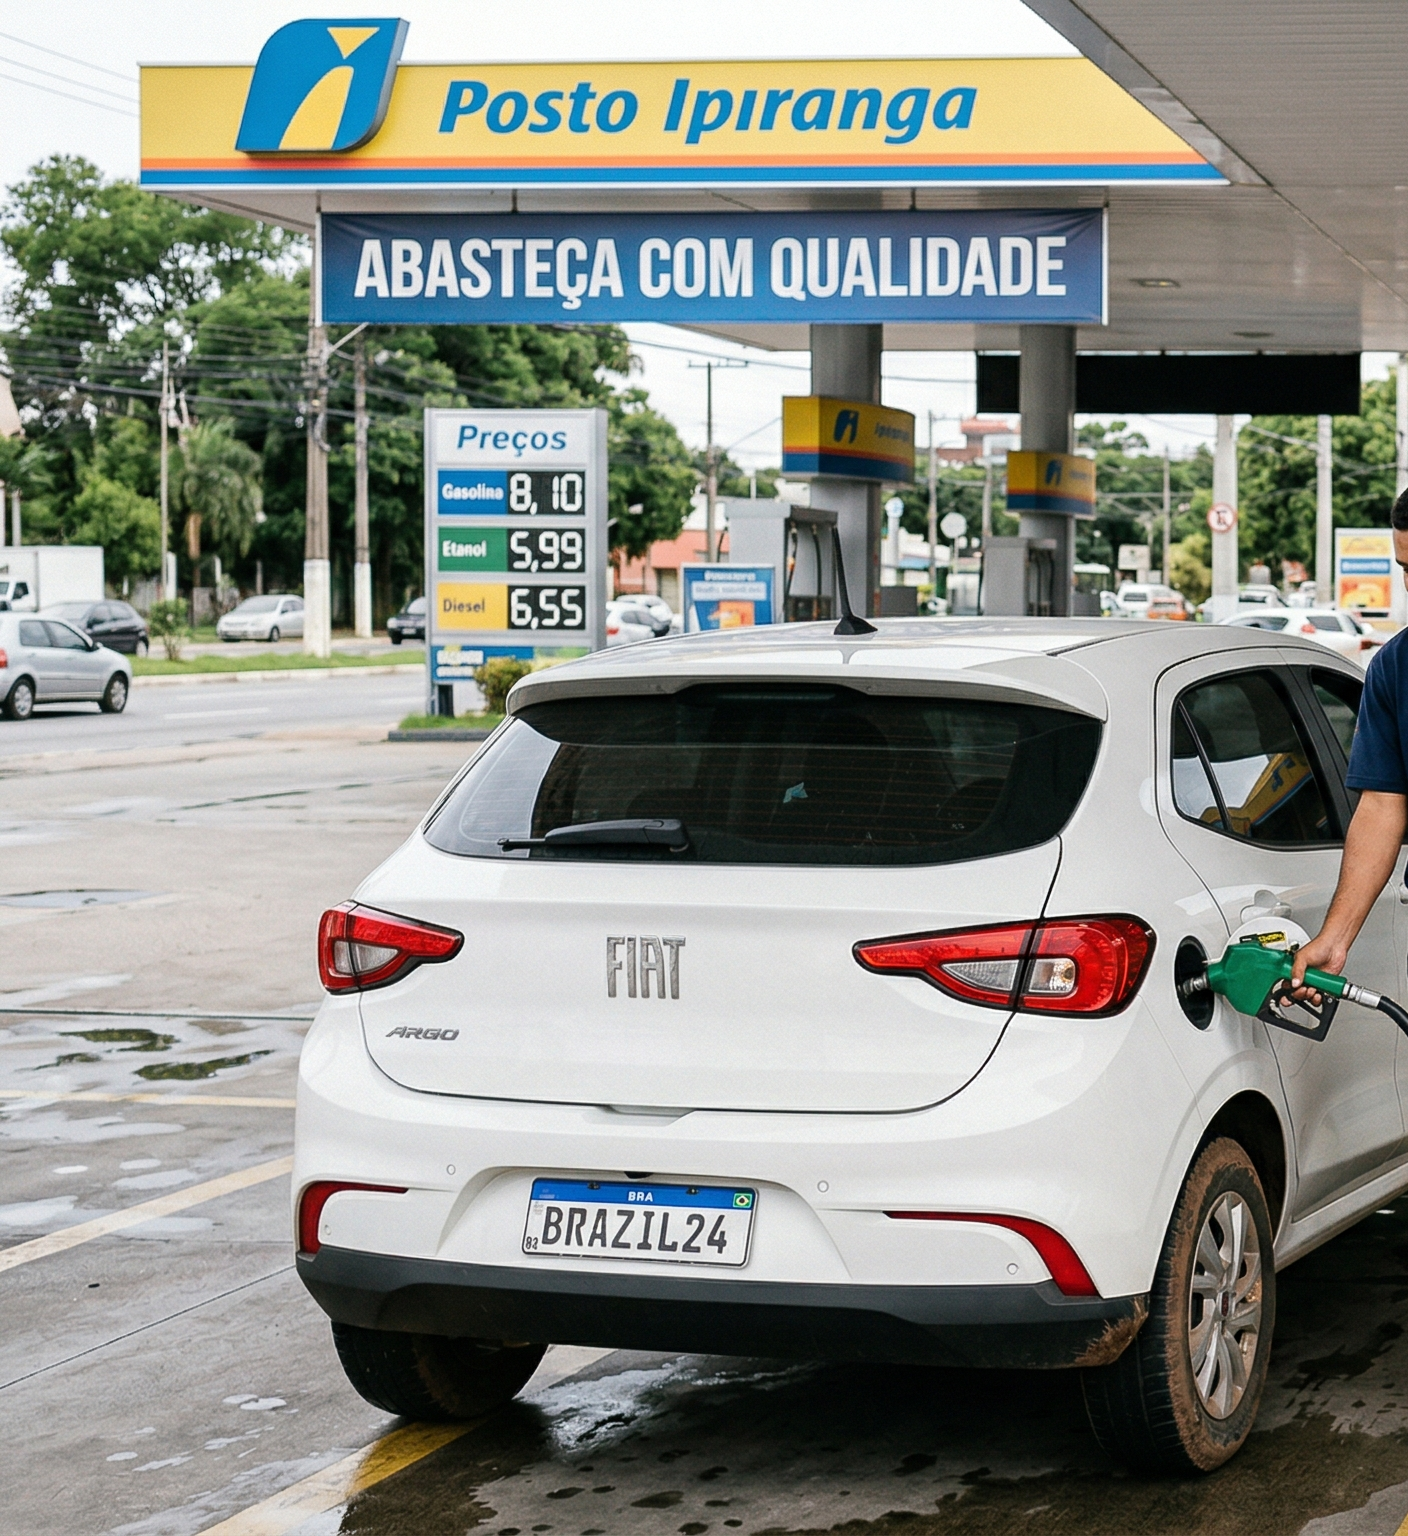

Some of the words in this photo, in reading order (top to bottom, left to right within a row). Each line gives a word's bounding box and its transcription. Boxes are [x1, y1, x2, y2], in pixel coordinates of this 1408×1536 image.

[438, 79, 639, 134] Posto
[353, 236, 625, 310] ABASTEÇA
[638, 237, 754, 299] COM
[769, 235, 1067, 301] QUALIDADE
[457, 424, 568, 457] Preços
[442, 483, 504, 501] Gasolina
[442, 540, 487, 558] Etanol
[509, 531, 583, 573] 5,99
[443, 598, 486, 613] Diesel
[510, 588, 583, 630] 6,55
[606, 934, 687, 1000] FIAT
[386, 1025, 460, 1042] ARGO
[627, 1190, 654, 1204] BRA
[541, 1205, 728, 1255] BRAZIL24
